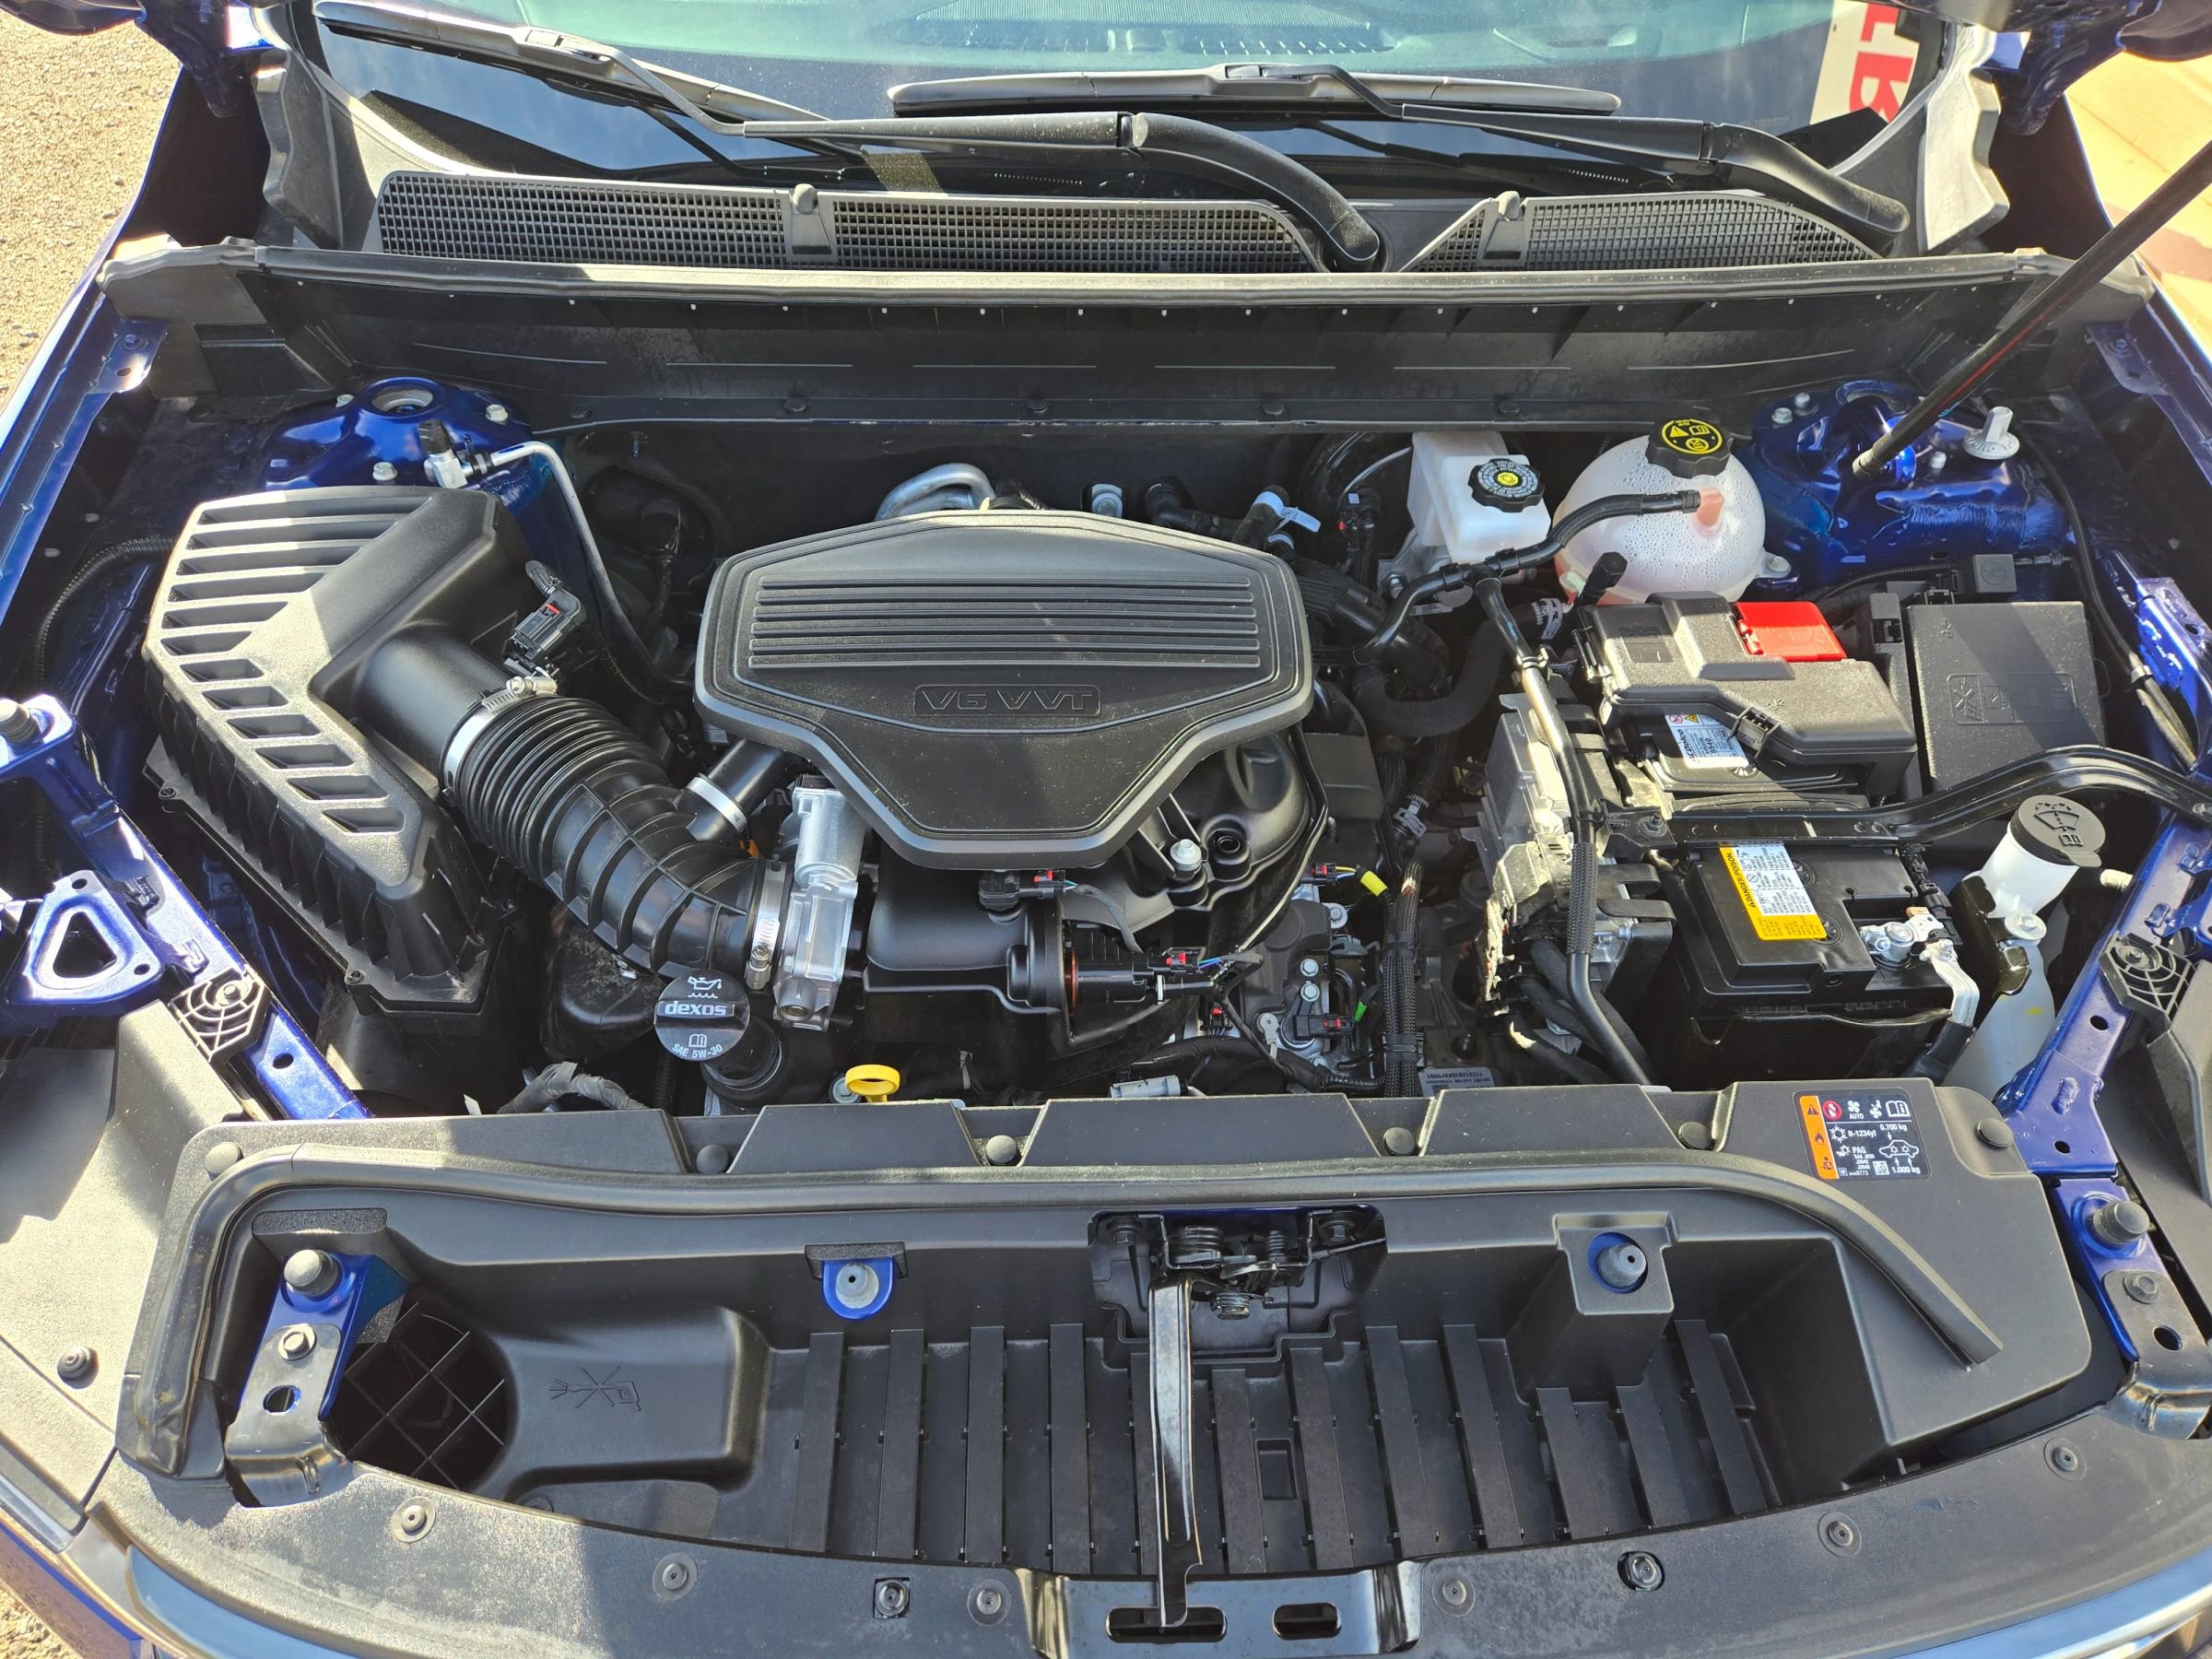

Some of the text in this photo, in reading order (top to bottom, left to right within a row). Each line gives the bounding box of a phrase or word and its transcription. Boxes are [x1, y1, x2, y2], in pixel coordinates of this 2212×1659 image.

[922, 689, 1092, 710] V6 VVT
[665, 1000, 728, 1016] dexos
[672, 1043, 723, 1059] SAE 5W-30
[1899, 1124, 1908, 1132] kg
[1911, 1166, 1921, 1174] kg
